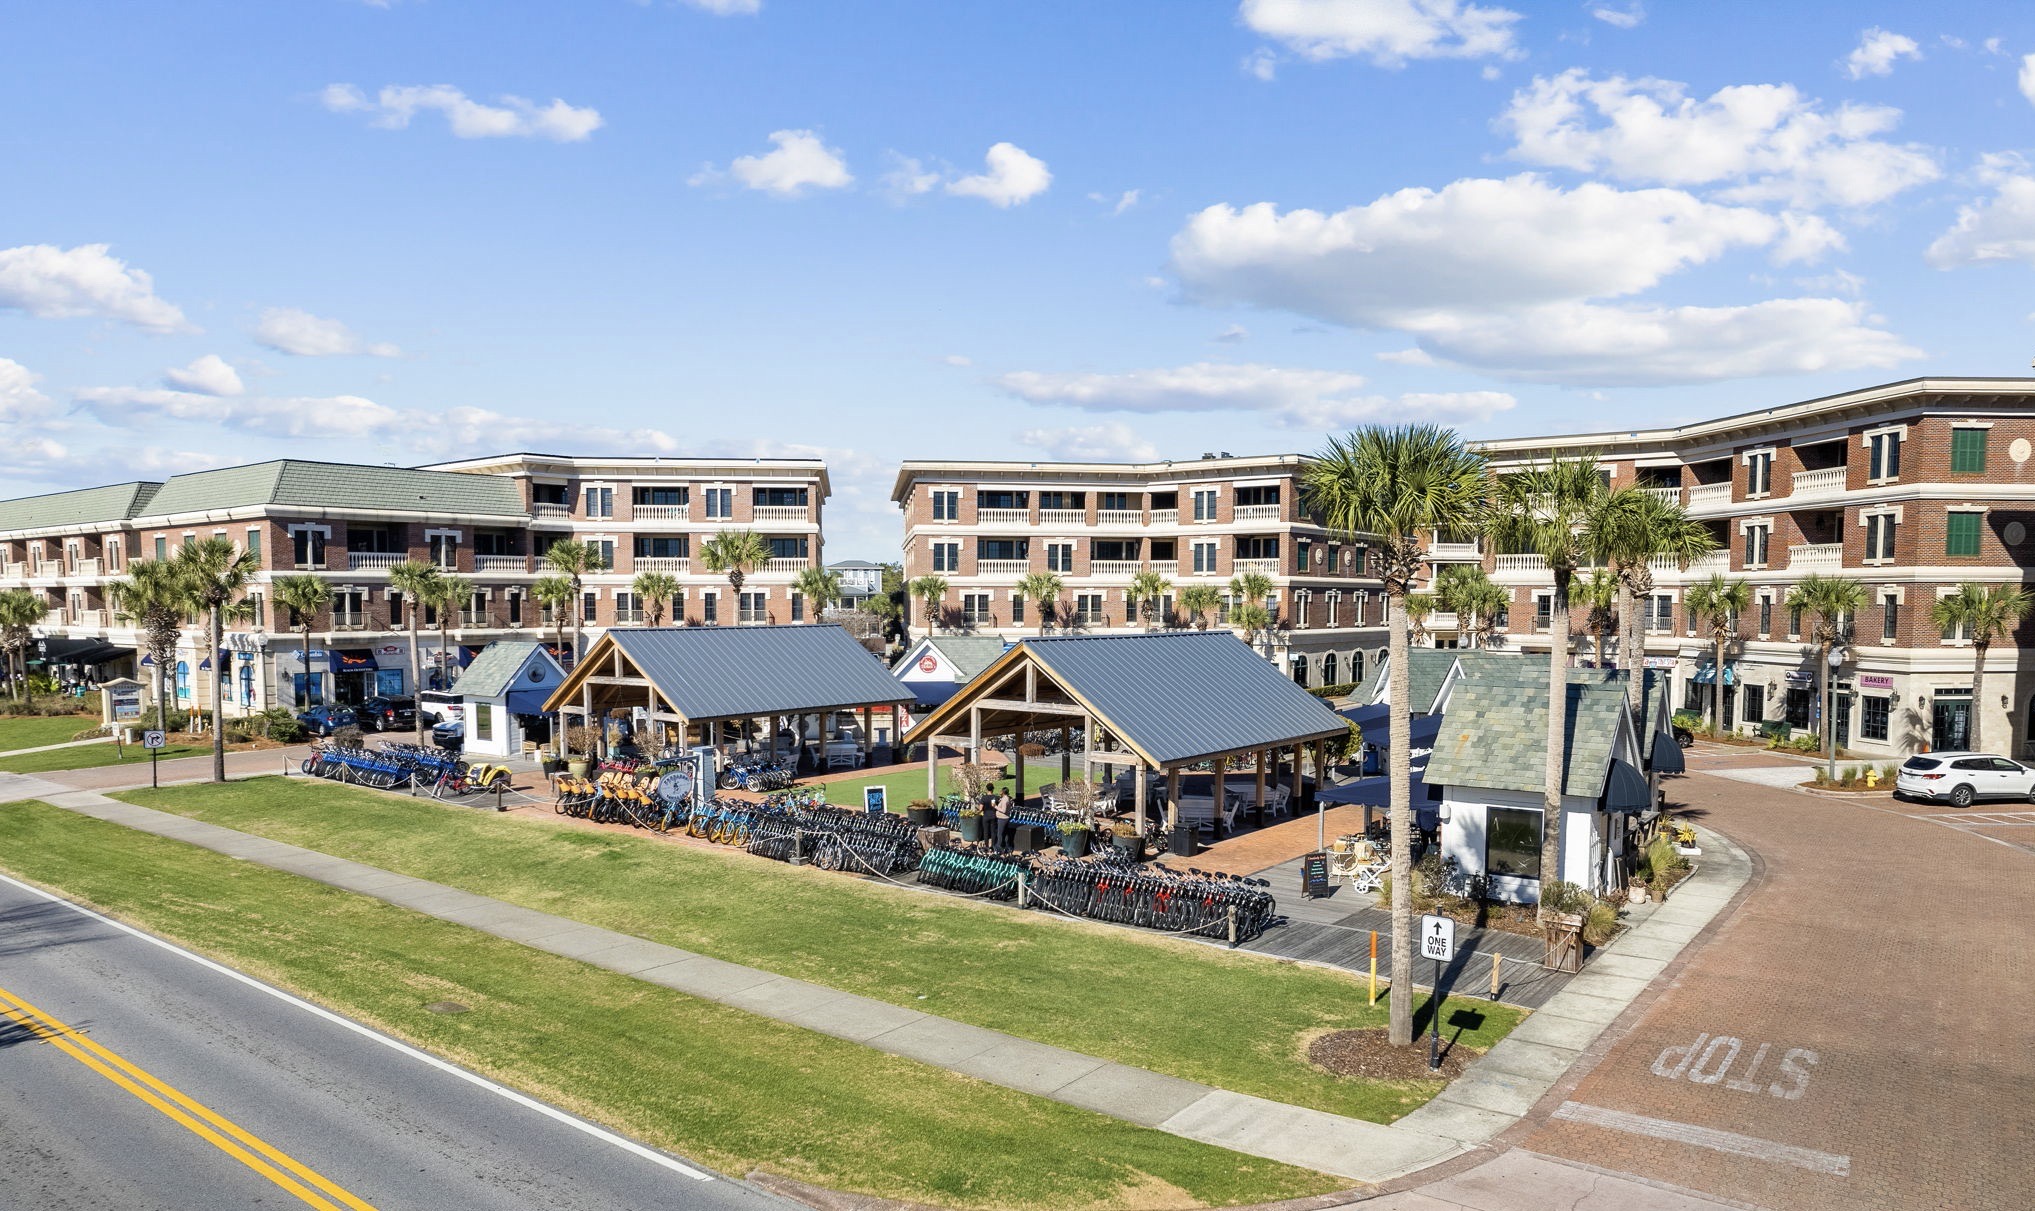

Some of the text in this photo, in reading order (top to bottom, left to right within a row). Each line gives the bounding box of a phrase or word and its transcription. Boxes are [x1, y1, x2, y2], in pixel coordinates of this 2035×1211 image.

[1865, 676, 1889, 684] BAKERY
[1428, 936, 1446, 947] ONE
[1427, 945, 1446, 956] WAY
[1652, 1033, 1818, 1100] STOP
